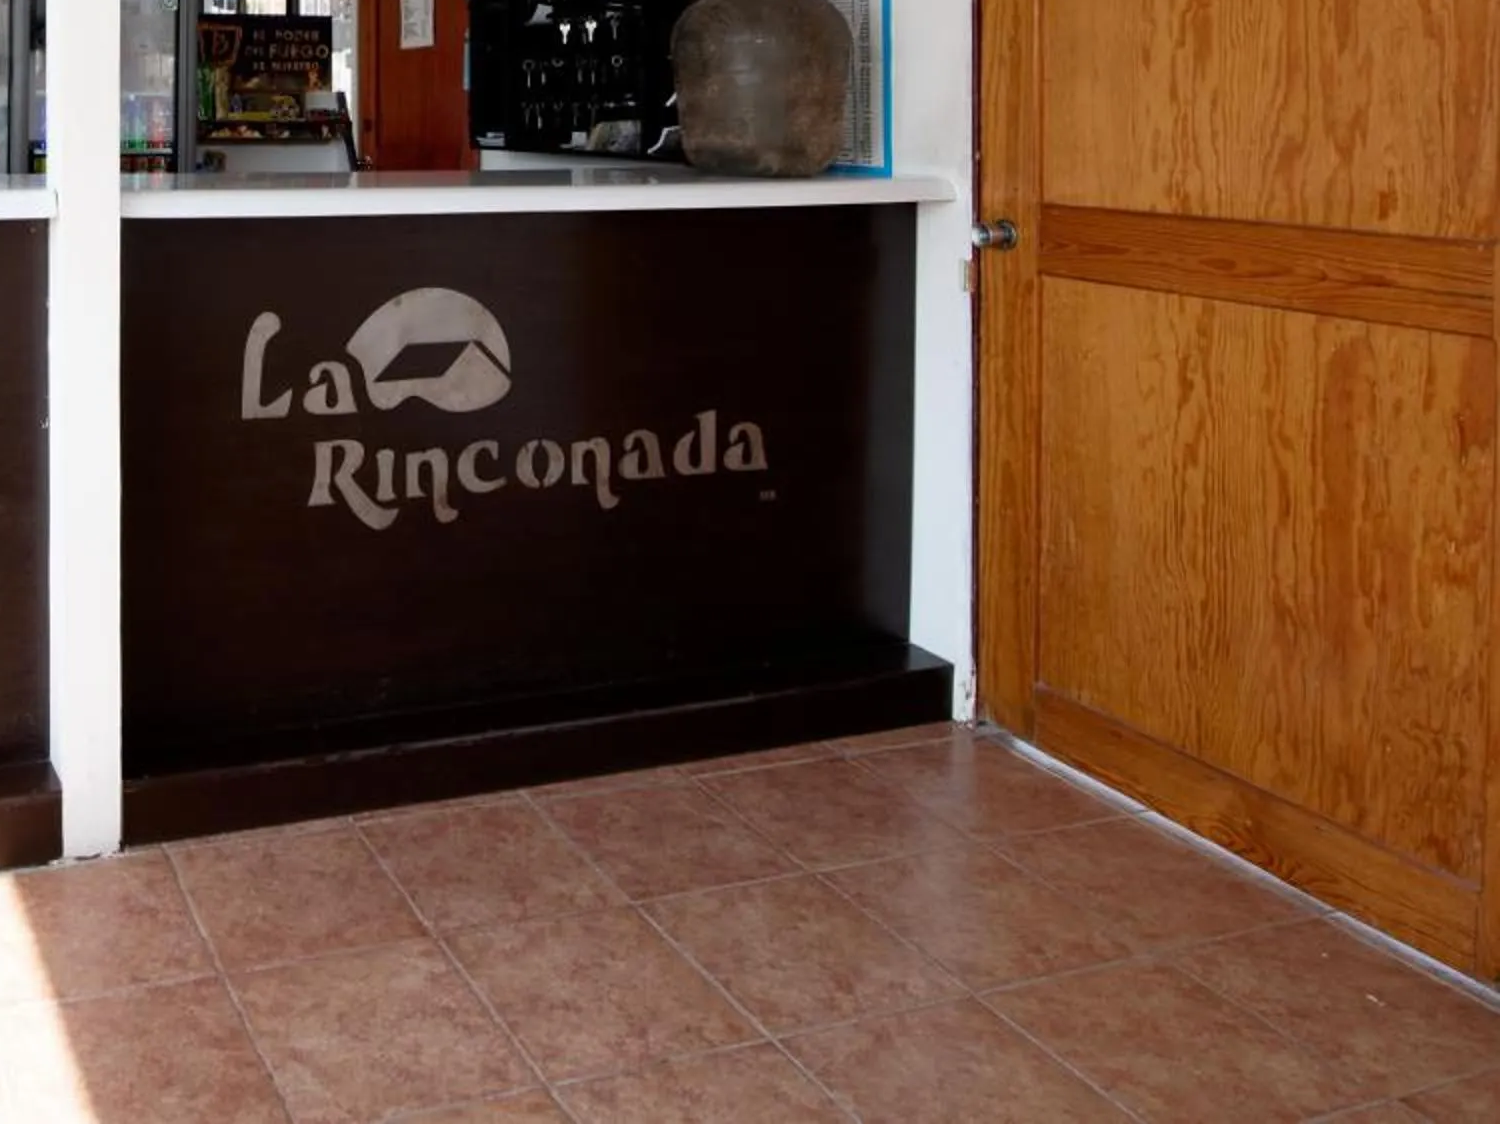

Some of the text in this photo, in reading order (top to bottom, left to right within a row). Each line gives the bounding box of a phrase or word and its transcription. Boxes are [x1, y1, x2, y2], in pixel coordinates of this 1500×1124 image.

[269, 44, 330, 60] FUEGO
[241, 311, 358, 420] La
[307, 409, 768, 531] Rinconada
